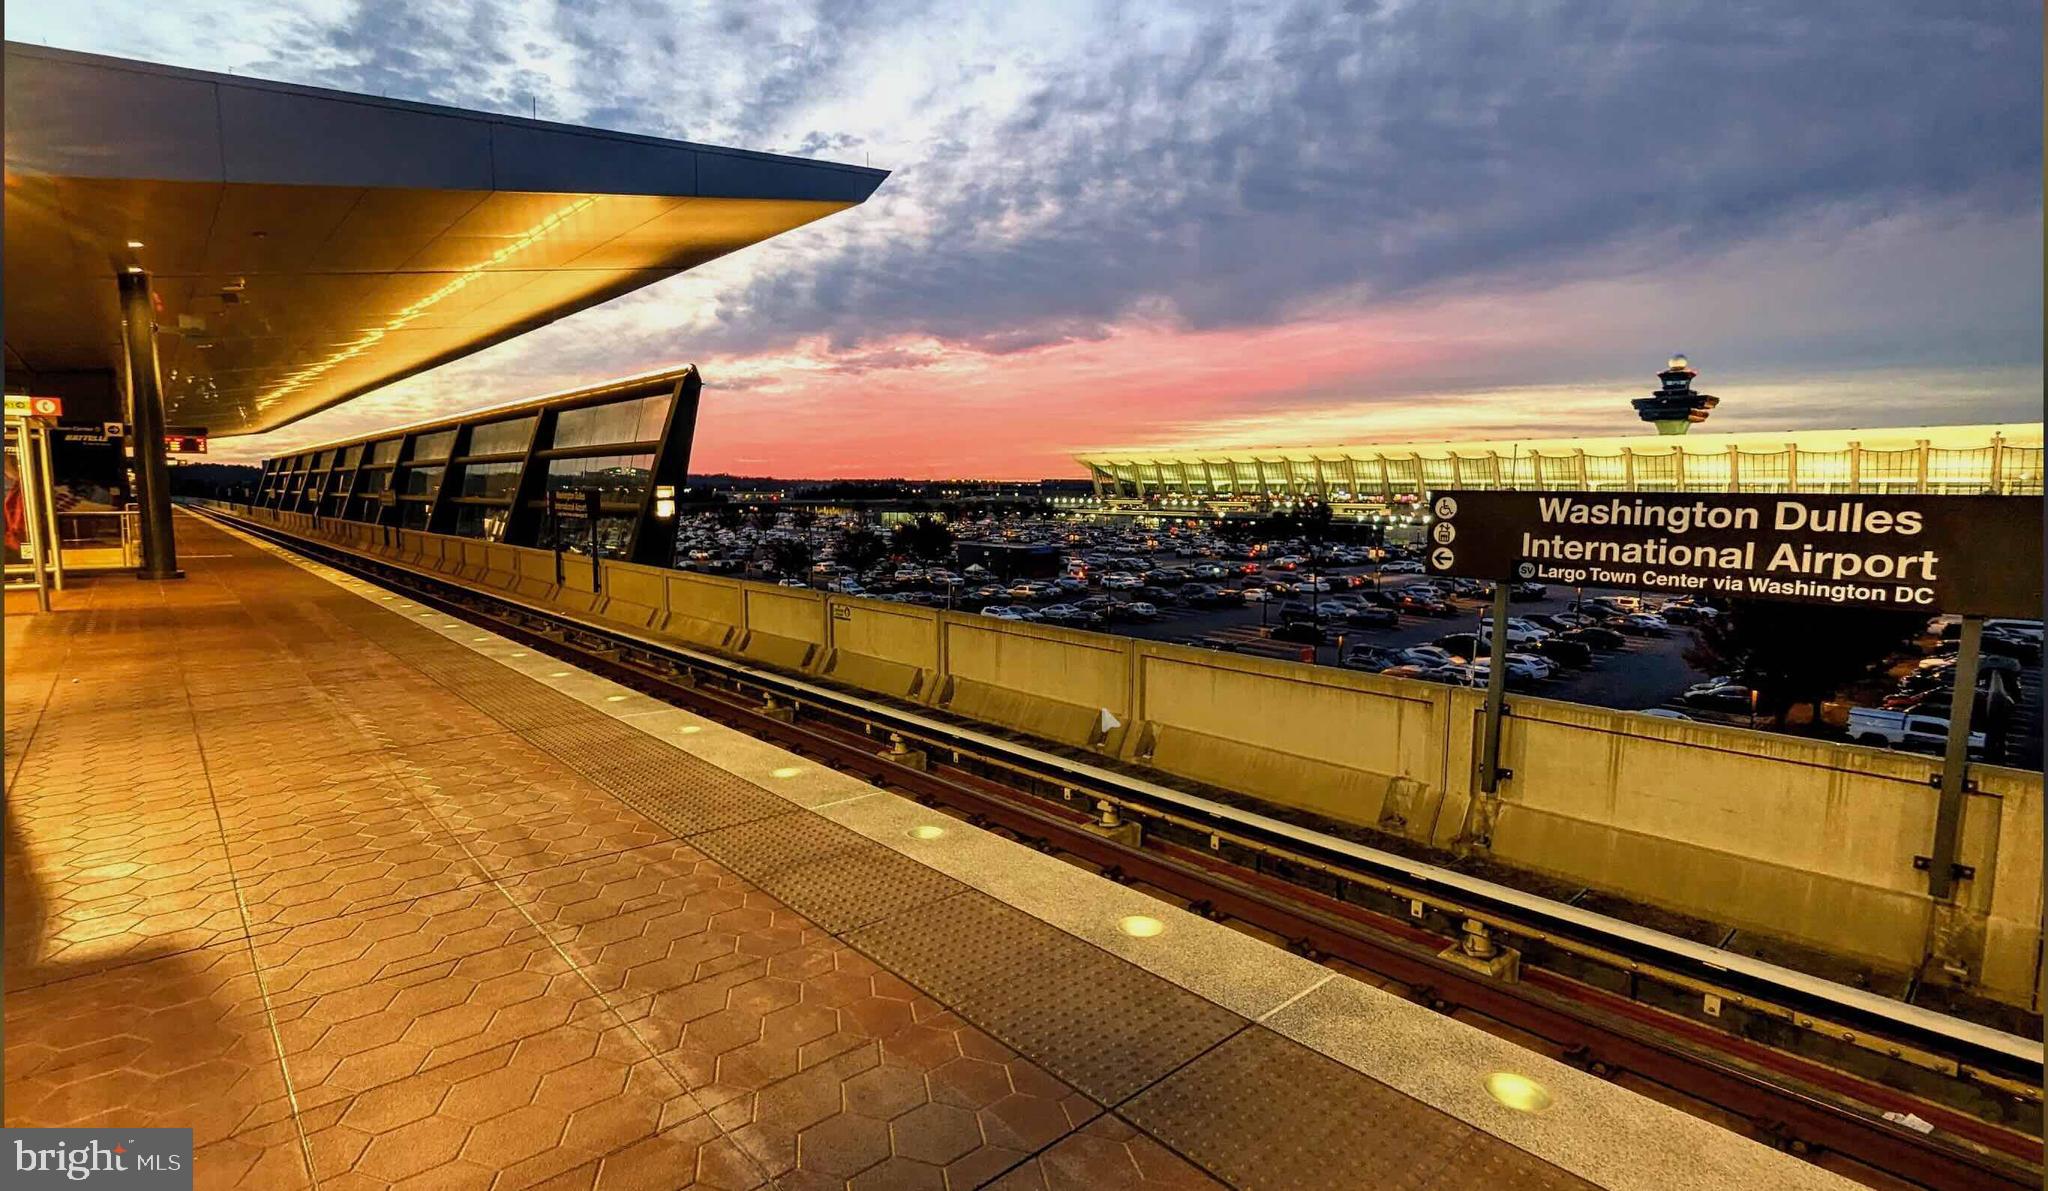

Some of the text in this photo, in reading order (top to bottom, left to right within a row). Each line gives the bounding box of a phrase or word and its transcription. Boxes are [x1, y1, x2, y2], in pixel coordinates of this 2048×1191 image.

[1538, 497, 1923, 535] Washington Dulles
[1522, 532, 1939, 581] International Airport
[1538, 564, 1586, 583] Largo
[1589, 567, 1637, 584] Town
[1642, 570, 1707, 589] Center
[1713, 575, 1743, 592] via
[1749, 577, 1886, 602] Washington
[1895, 586, 1935, 605] DC
